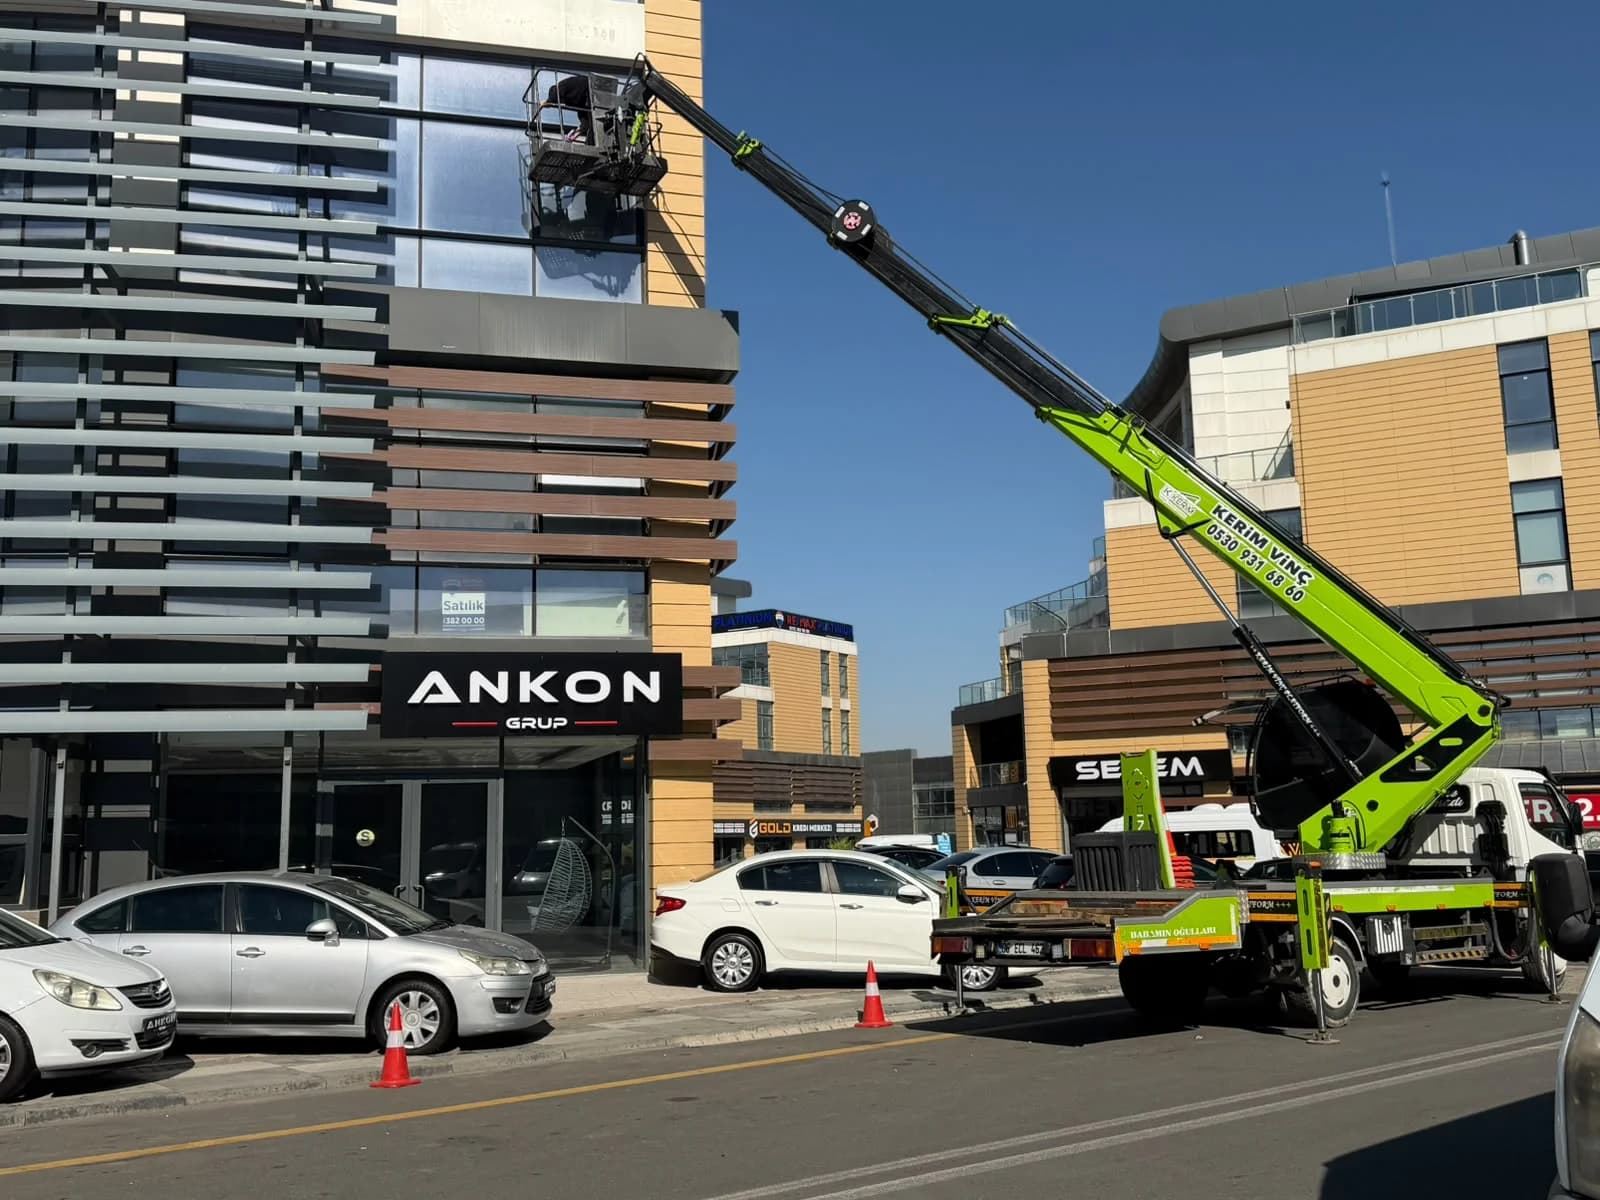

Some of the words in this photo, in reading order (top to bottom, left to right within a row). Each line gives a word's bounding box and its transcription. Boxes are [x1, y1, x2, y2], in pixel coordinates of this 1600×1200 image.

[1206, 524, 1239, 552] 0530
[1240, 550, 1265, 572] 931
[1265, 570, 1285, 588] 68
[1285, 585, 1305, 602] 60
[407, 670, 660, 703] ANKON
[505, 717, 568, 729] GRUP
[1076, 756, 1205, 780] SEEM
[759, 822, 791, 834] GOLD
